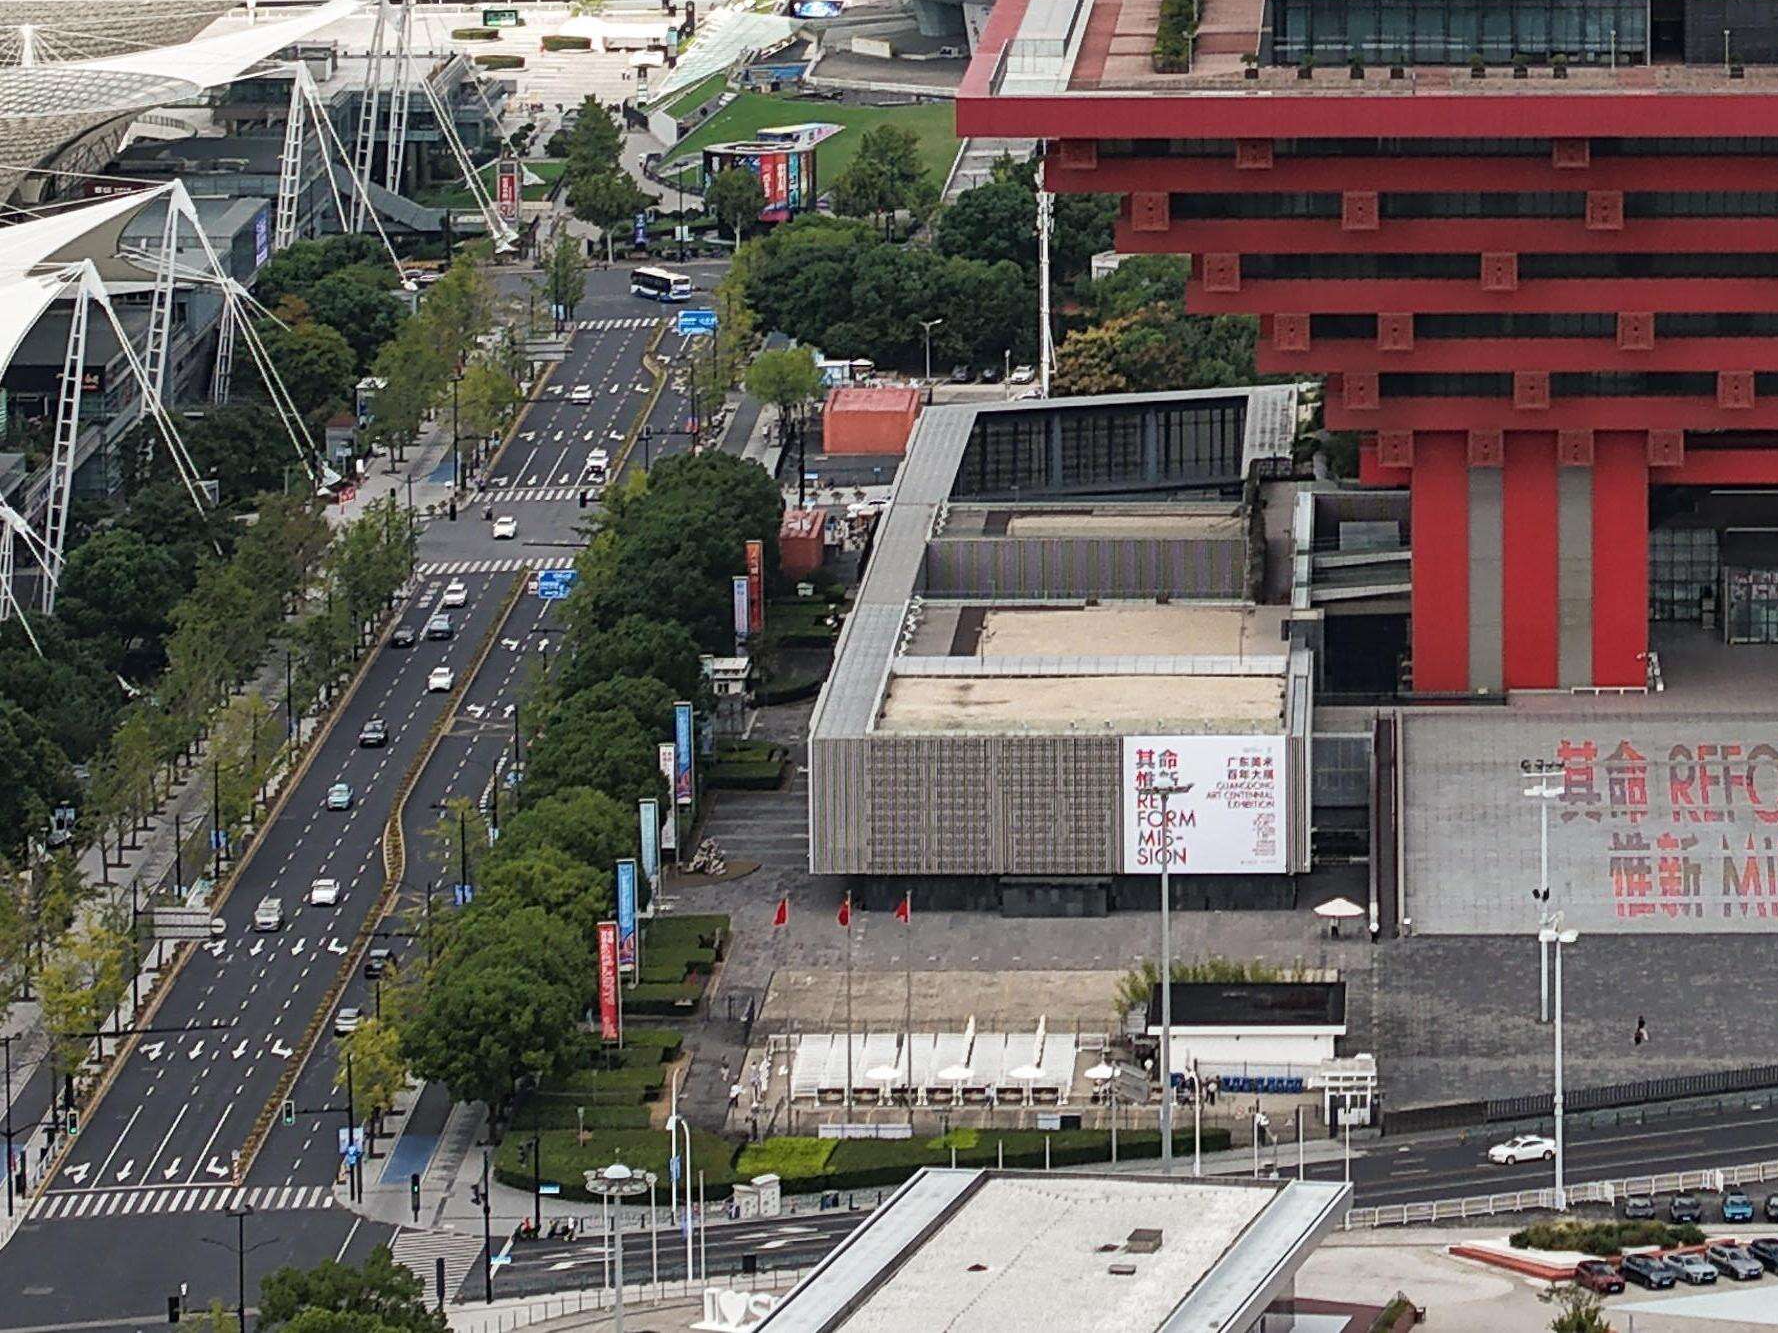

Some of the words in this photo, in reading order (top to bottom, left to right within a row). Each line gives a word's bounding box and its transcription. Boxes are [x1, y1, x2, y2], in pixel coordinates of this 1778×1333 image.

[1136, 749, 1177, 769] 其命
[1137, 810, 1197, 827] FORM
[1137, 848, 1187, 865] SION
